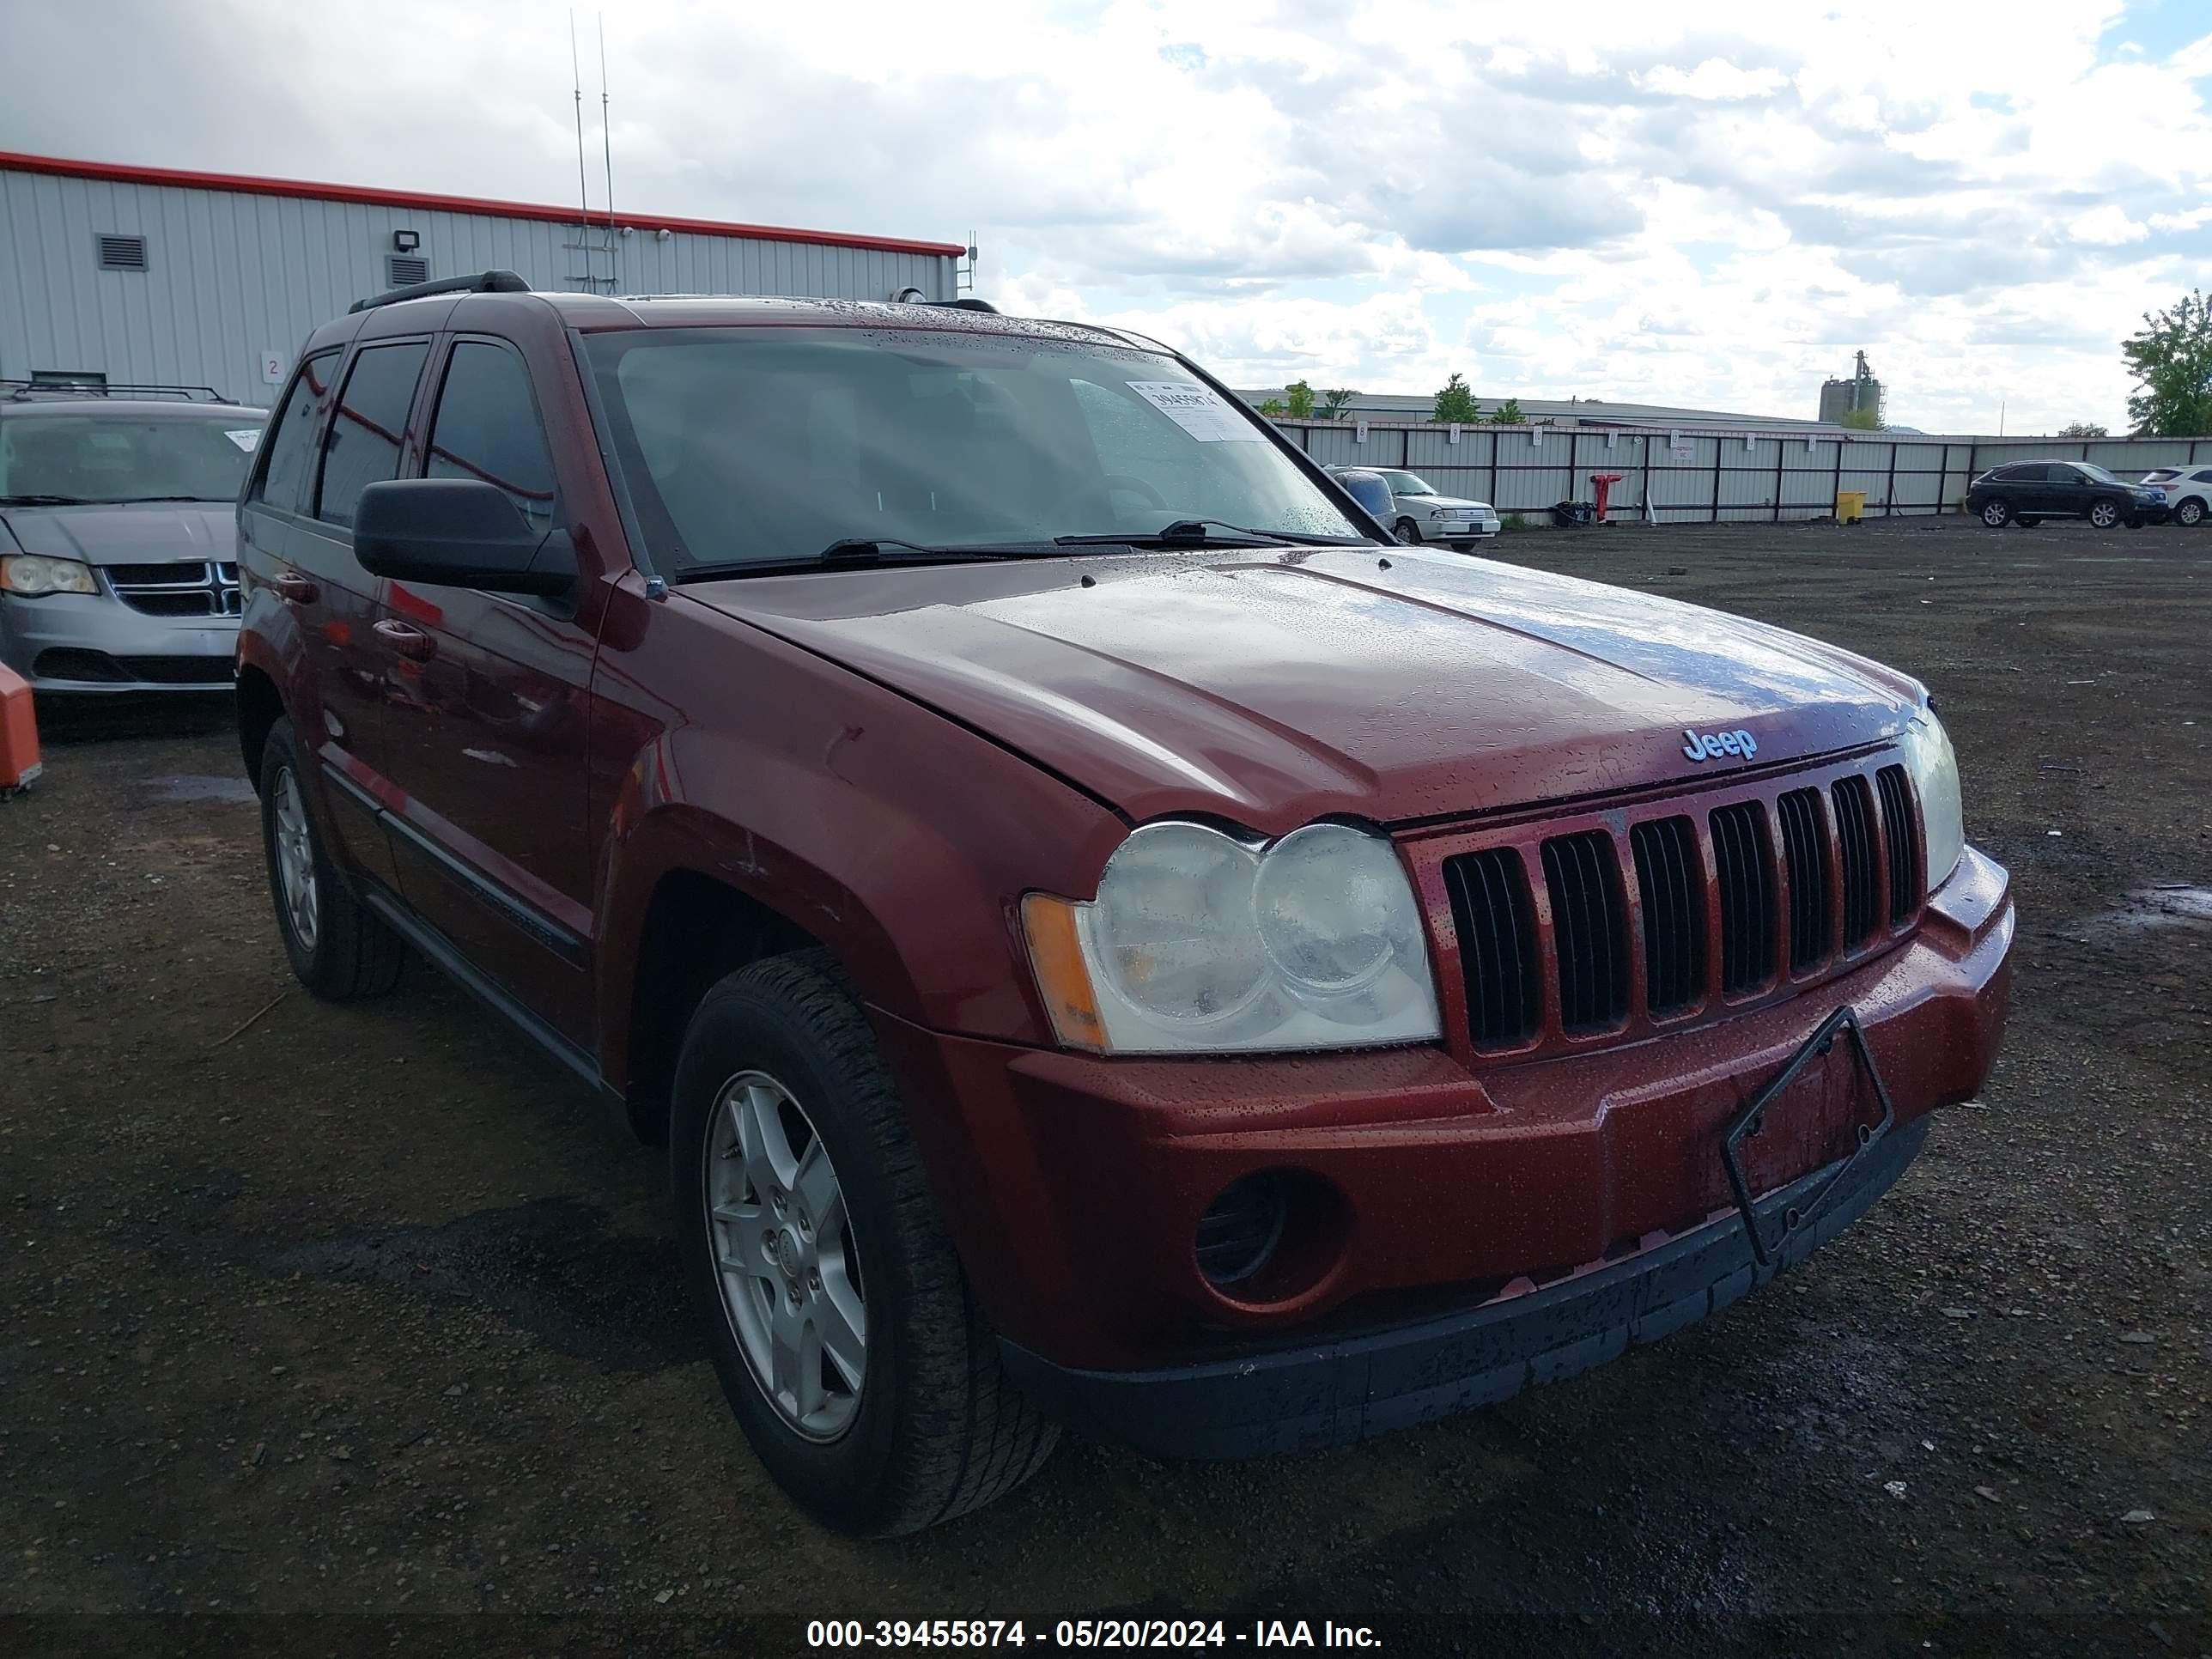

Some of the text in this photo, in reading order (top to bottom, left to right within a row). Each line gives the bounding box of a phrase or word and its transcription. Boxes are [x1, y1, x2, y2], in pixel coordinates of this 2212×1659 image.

[269, 360, 278, 374] 2
[1152, 394, 1219, 406] 39455874
[1359, 427, 1365, 436] 8
[1453, 428, 1457, 438] 9
[1534, 432, 1540, 441] 10
[1682, 729, 1758, 762] Jeep
